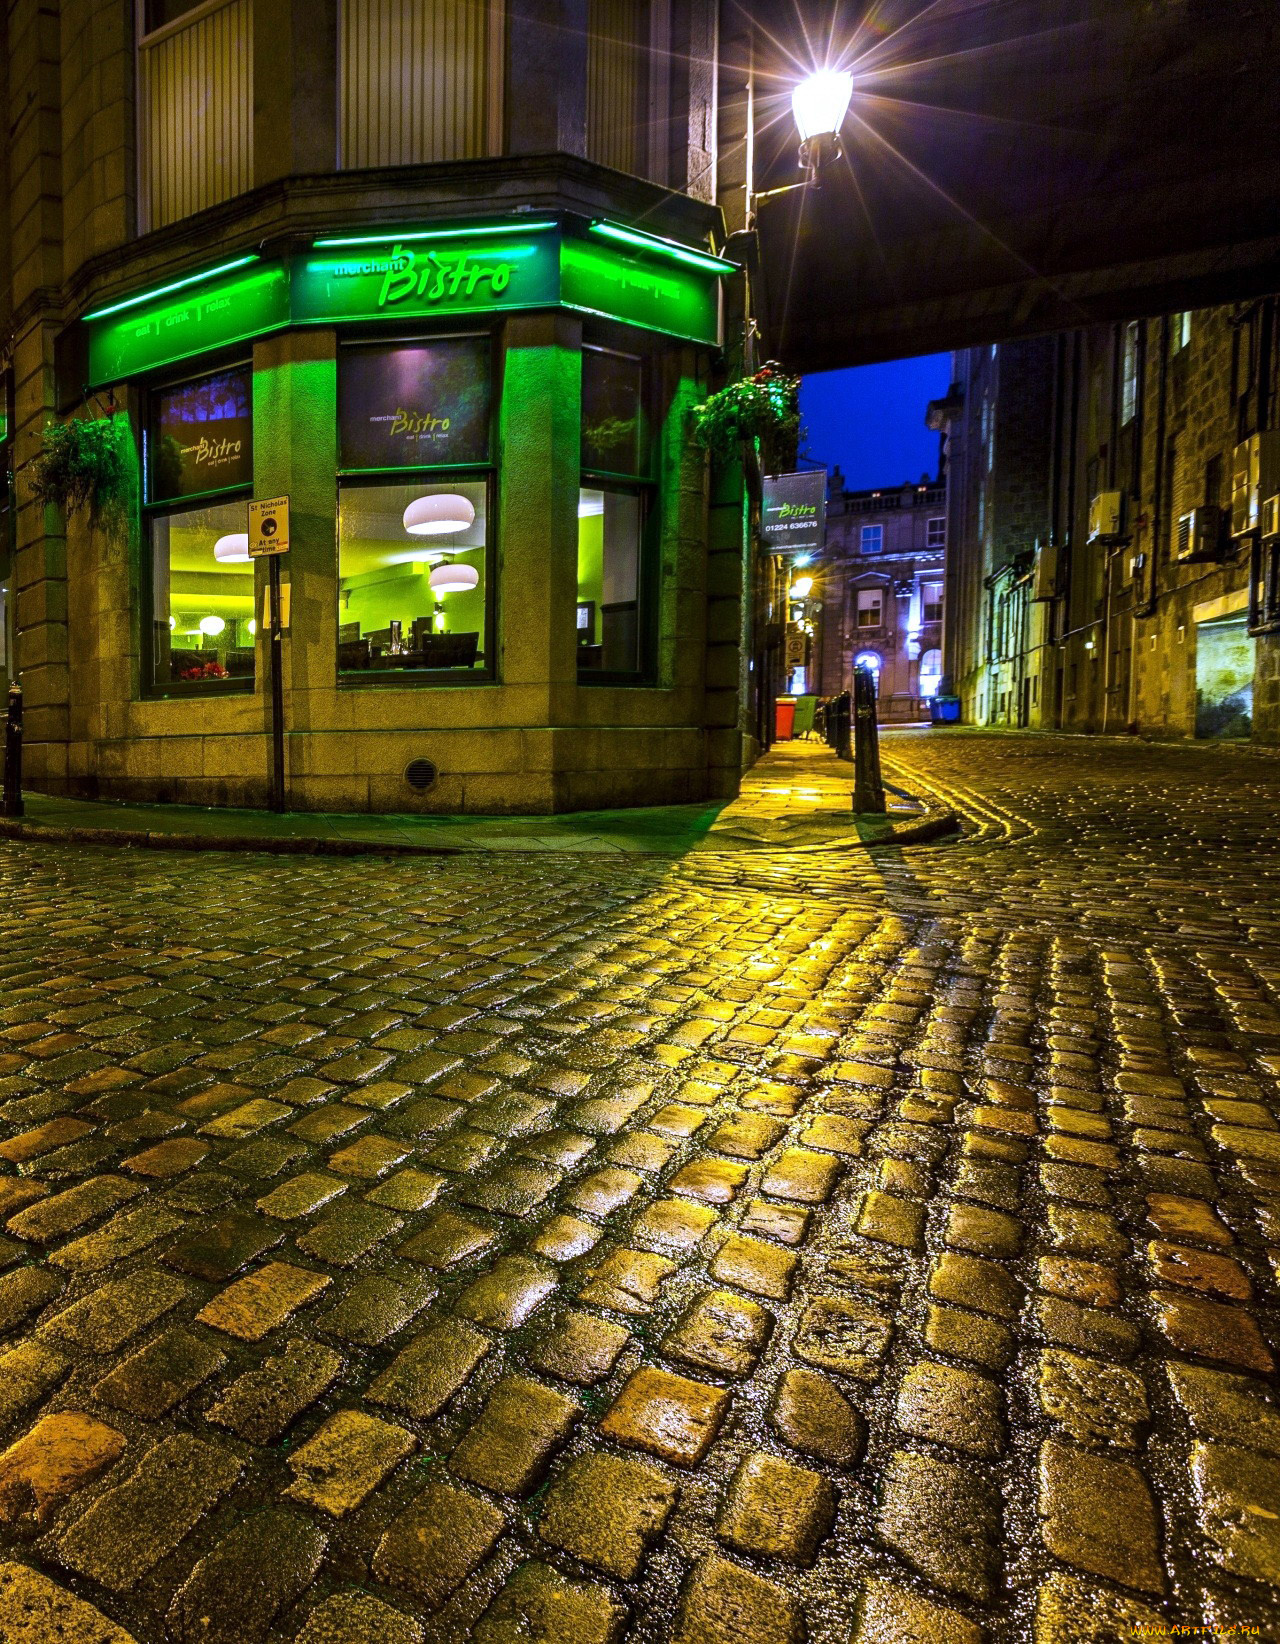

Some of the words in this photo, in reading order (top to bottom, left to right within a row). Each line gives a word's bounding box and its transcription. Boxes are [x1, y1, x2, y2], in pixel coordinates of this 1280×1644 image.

[334, 258, 406, 275] merchant
[378, 244, 519, 306] Bistro
[135, 323, 150, 337] eat
[165, 311, 190, 327] drink
[205, 297, 231, 314] relax
[389, 407, 450, 436] Bistro
[195, 436, 241, 465] Bistro
[260, 500, 287, 510] Nicholas
[778, 503, 816, 518] Bistro
[765, 524, 788, 532] 01224
